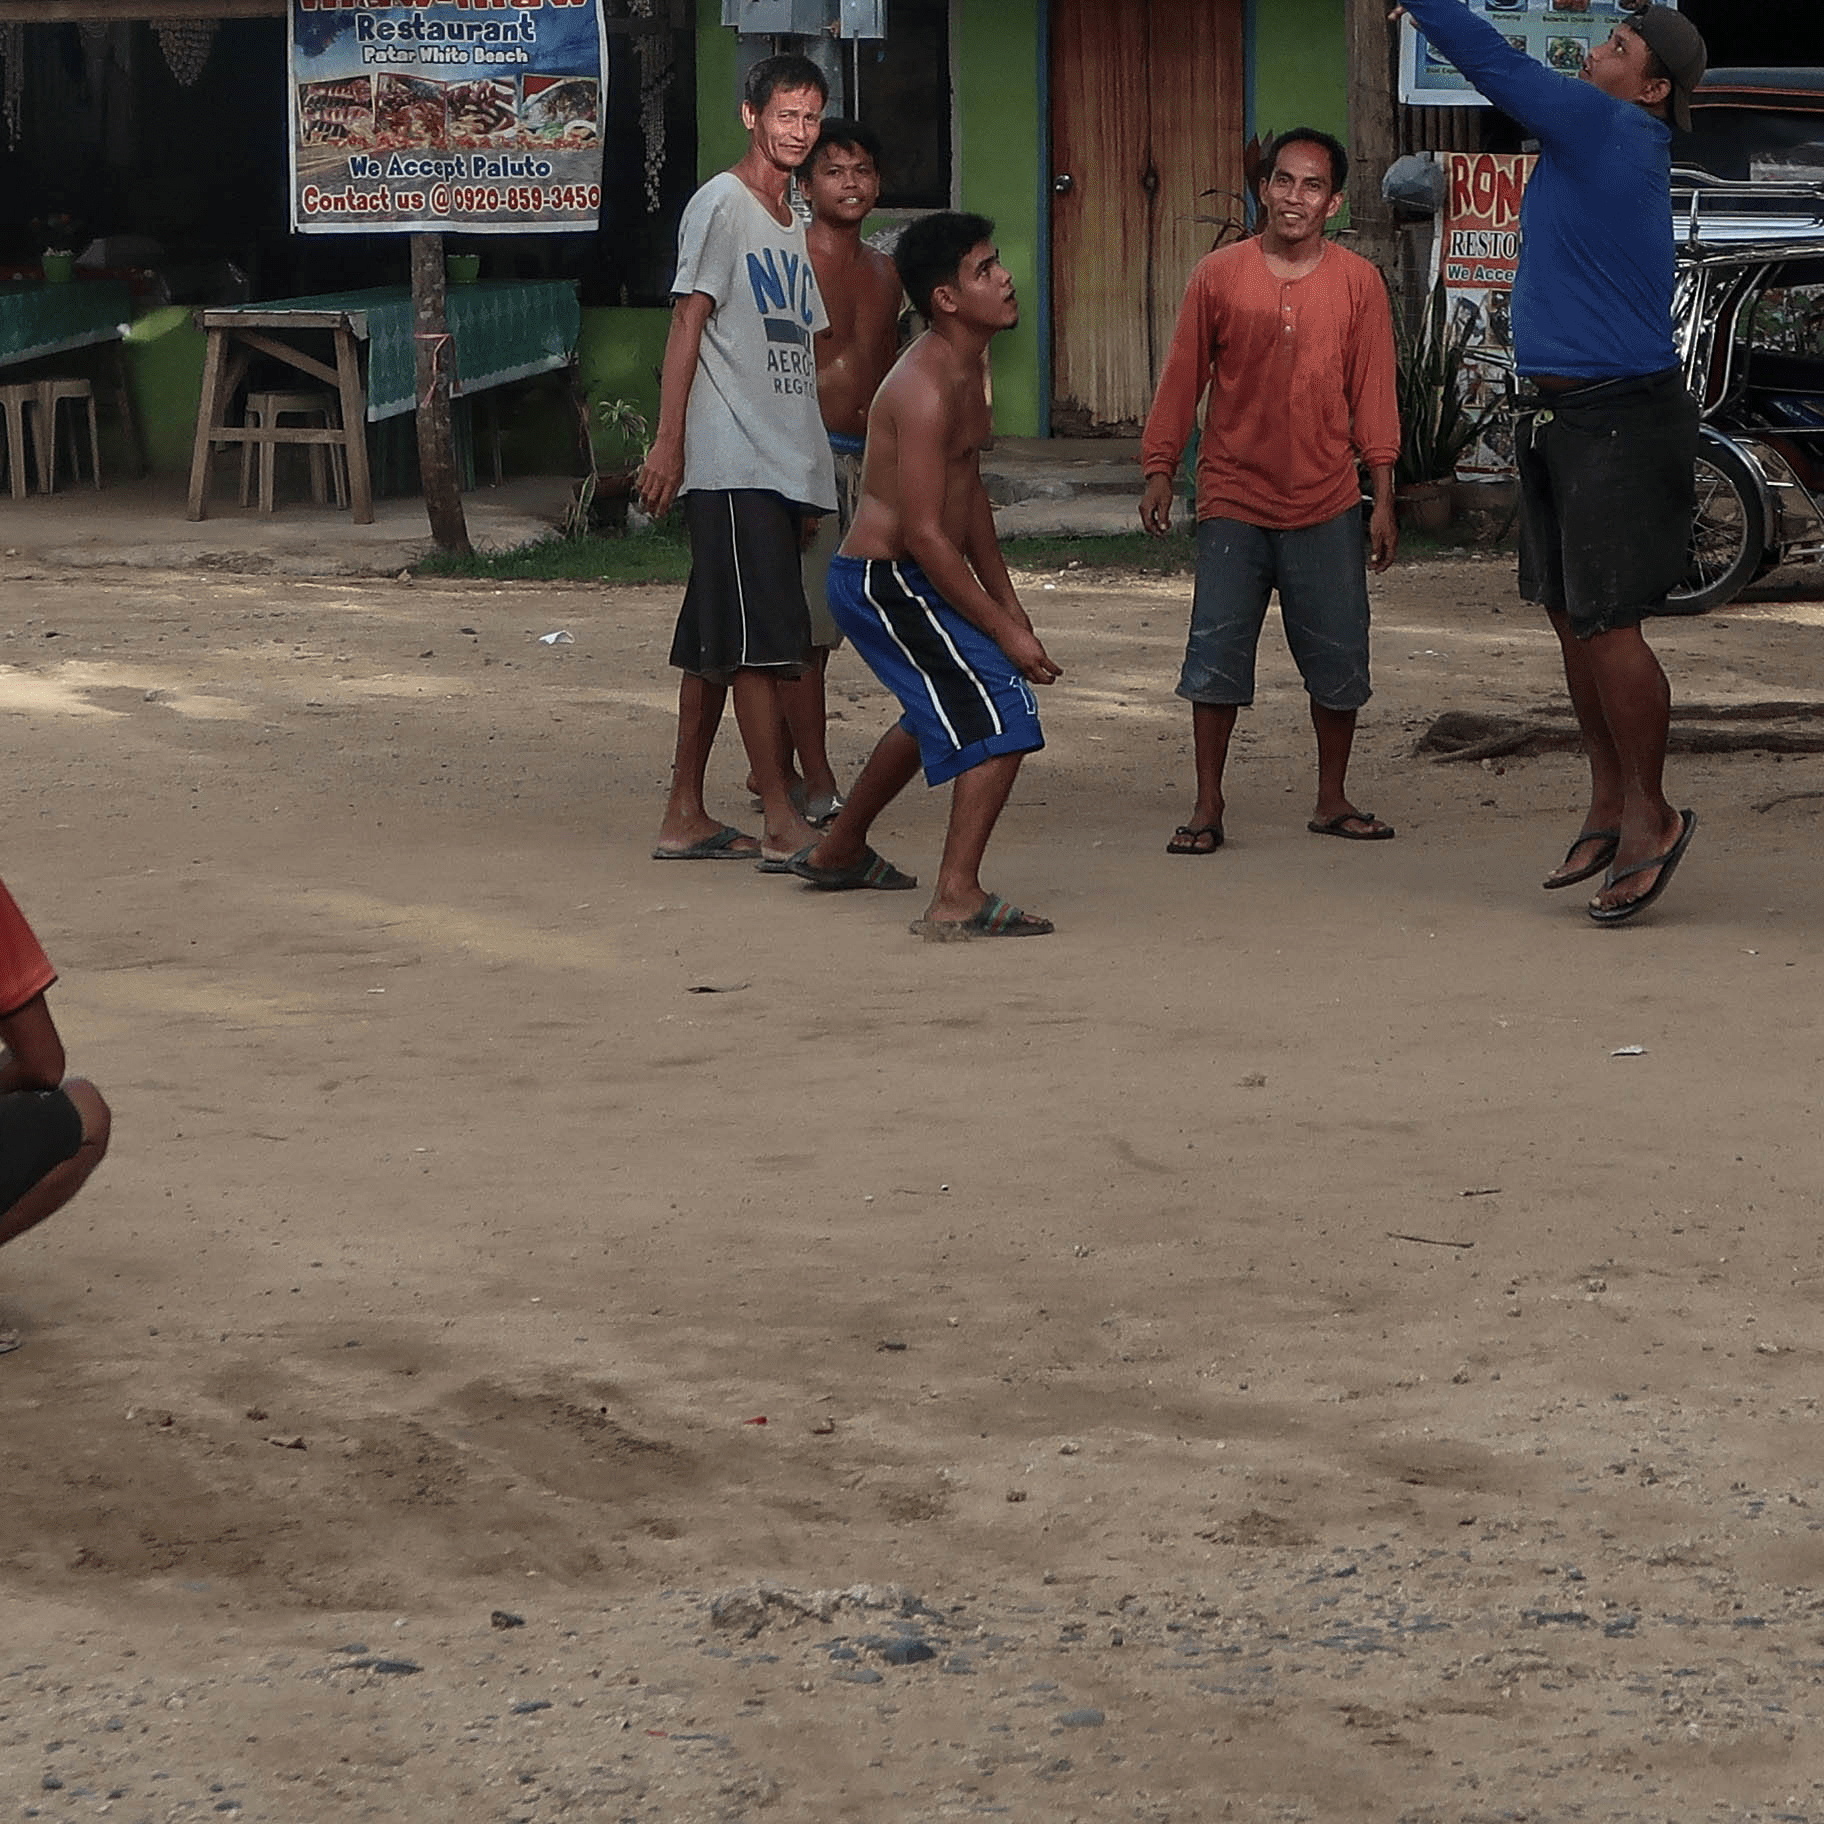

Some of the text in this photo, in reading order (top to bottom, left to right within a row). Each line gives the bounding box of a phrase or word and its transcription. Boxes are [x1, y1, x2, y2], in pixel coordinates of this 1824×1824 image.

[356, 12, 536, 43] Restaurant
[362, 46, 529, 64] Patar White Beach
[349, 153, 553, 182] We Accept Paluto
[302, 183, 602, 215] Contact us @ 0920-859-3450
[1450, 153, 1524, 226] RON
[1450, 230, 1518, 259] RESTO
[746, 247, 814, 326] NYC
[1447, 264, 1469, 281] We
